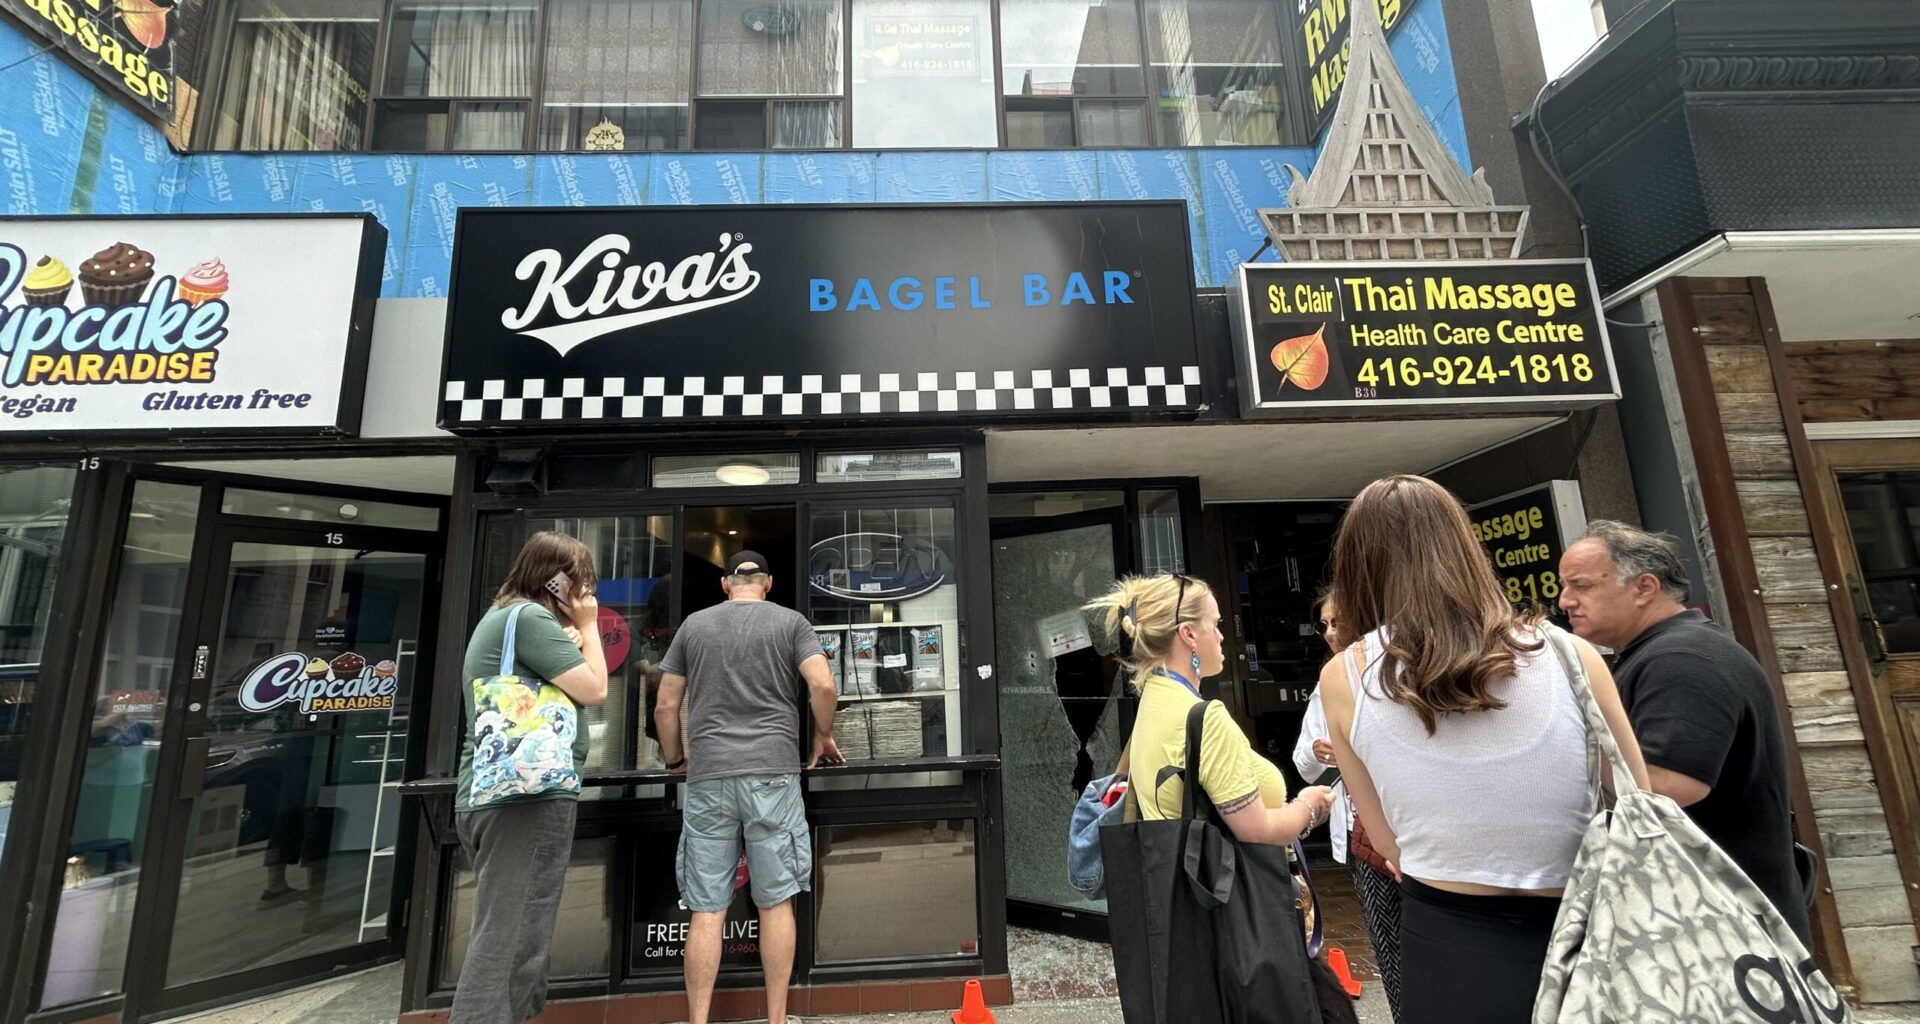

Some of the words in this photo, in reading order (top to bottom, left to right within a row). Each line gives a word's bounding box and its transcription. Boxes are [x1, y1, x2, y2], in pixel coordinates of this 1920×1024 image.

[899, 23, 922, 34] Thai
[924, 23, 970, 37] Massage
[501, 232, 761, 336] Kiva's
[810, 275, 991, 312] BAGEL
[1024, 270, 1134, 306] BAR
[1267, 285, 1292, 314] St.
[1295, 283, 1334, 314] Clair
[1343, 276, 1417, 312] Thai
[1423, 276, 1577, 323] Massage
[0, 243, 229, 388] upcake
[1350, 323, 1428, 347] Health
[1433, 322, 1491, 346] Care
[1496, 319, 1584, 344] Centre
[26, 351, 215, 383] PARADISE
[1357, 353, 1594, 388] 416-924-1818
[0, 394, 77, 419] egan
[142, 391, 243, 411] Gluten
[247, 388, 312, 409] free
[79, 457, 100, 471] 15
[1471, 506, 1544, 542] assage
[325, 532, 344, 546] 15
[1494, 543, 1550, 569] Centre
[239, 651, 397, 713] Cupcake
[1293, 688, 1310, 703] 15
[311, 696, 392, 711] PARADISE
[647, 922, 690, 943] FREE
[644, 946, 663, 958] Call
[665, 945, 678, 957] for
